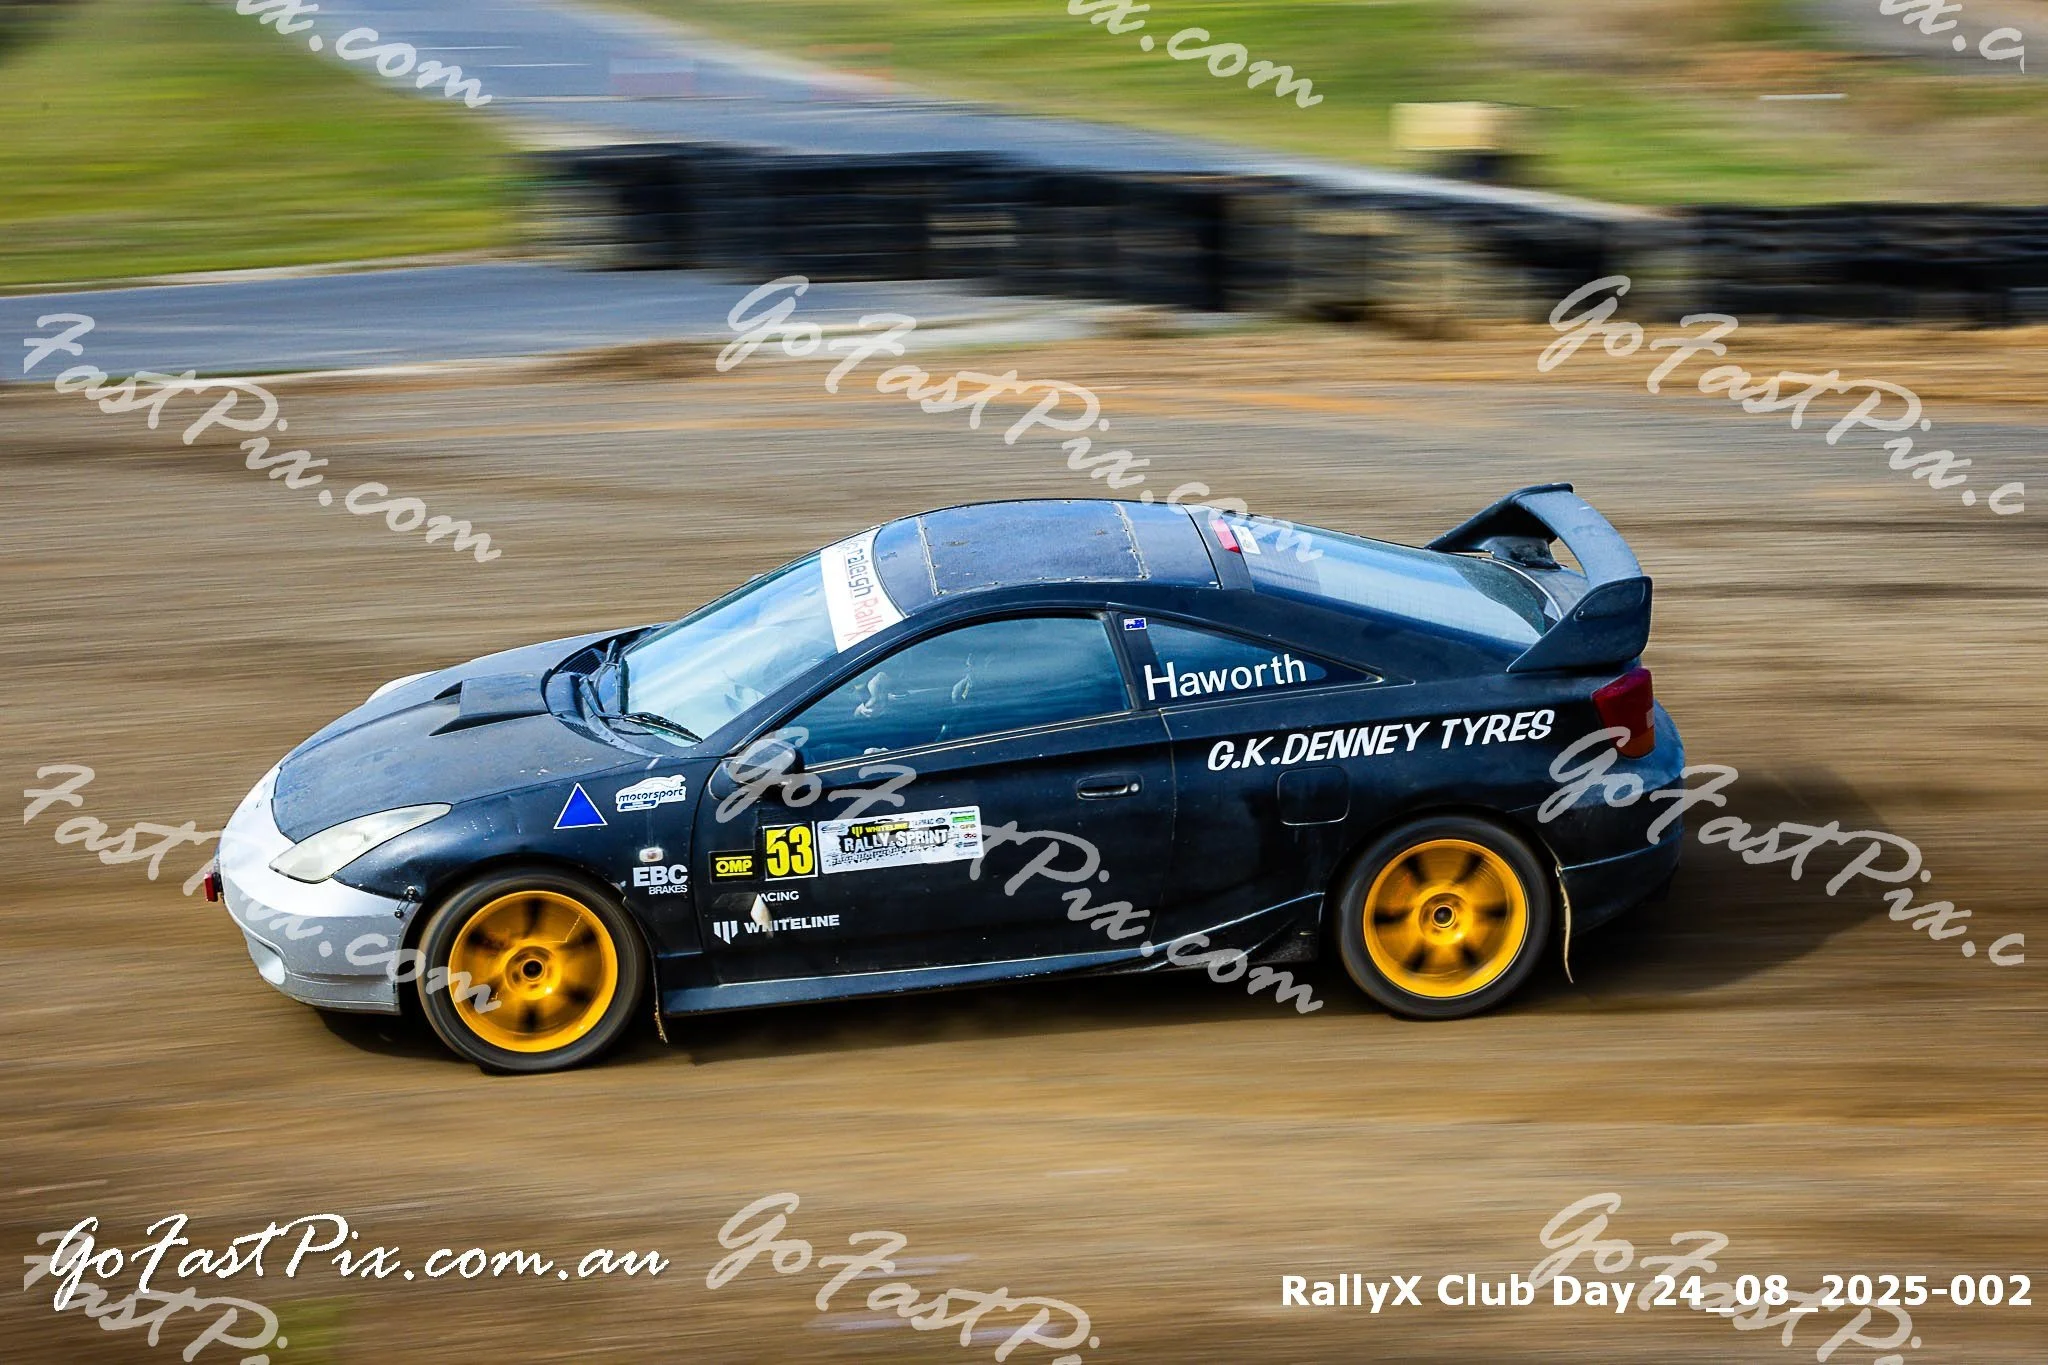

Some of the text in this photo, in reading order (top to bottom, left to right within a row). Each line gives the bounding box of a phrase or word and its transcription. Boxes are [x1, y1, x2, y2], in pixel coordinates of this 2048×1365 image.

[1144, 654, 1306, 701] Haworth
[1207, 709, 1555, 771] G.K.DENNEY TYRES
[619, 788, 684, 802] motorsport
[766, 826, 814, 876] 53
[843, 829, 948, 853] RALLY SPRINT
[633, 864, 688, 887] EBC
[716, 859, 753, 874] OMP
[649, 884, 688, 895] BRAKES
